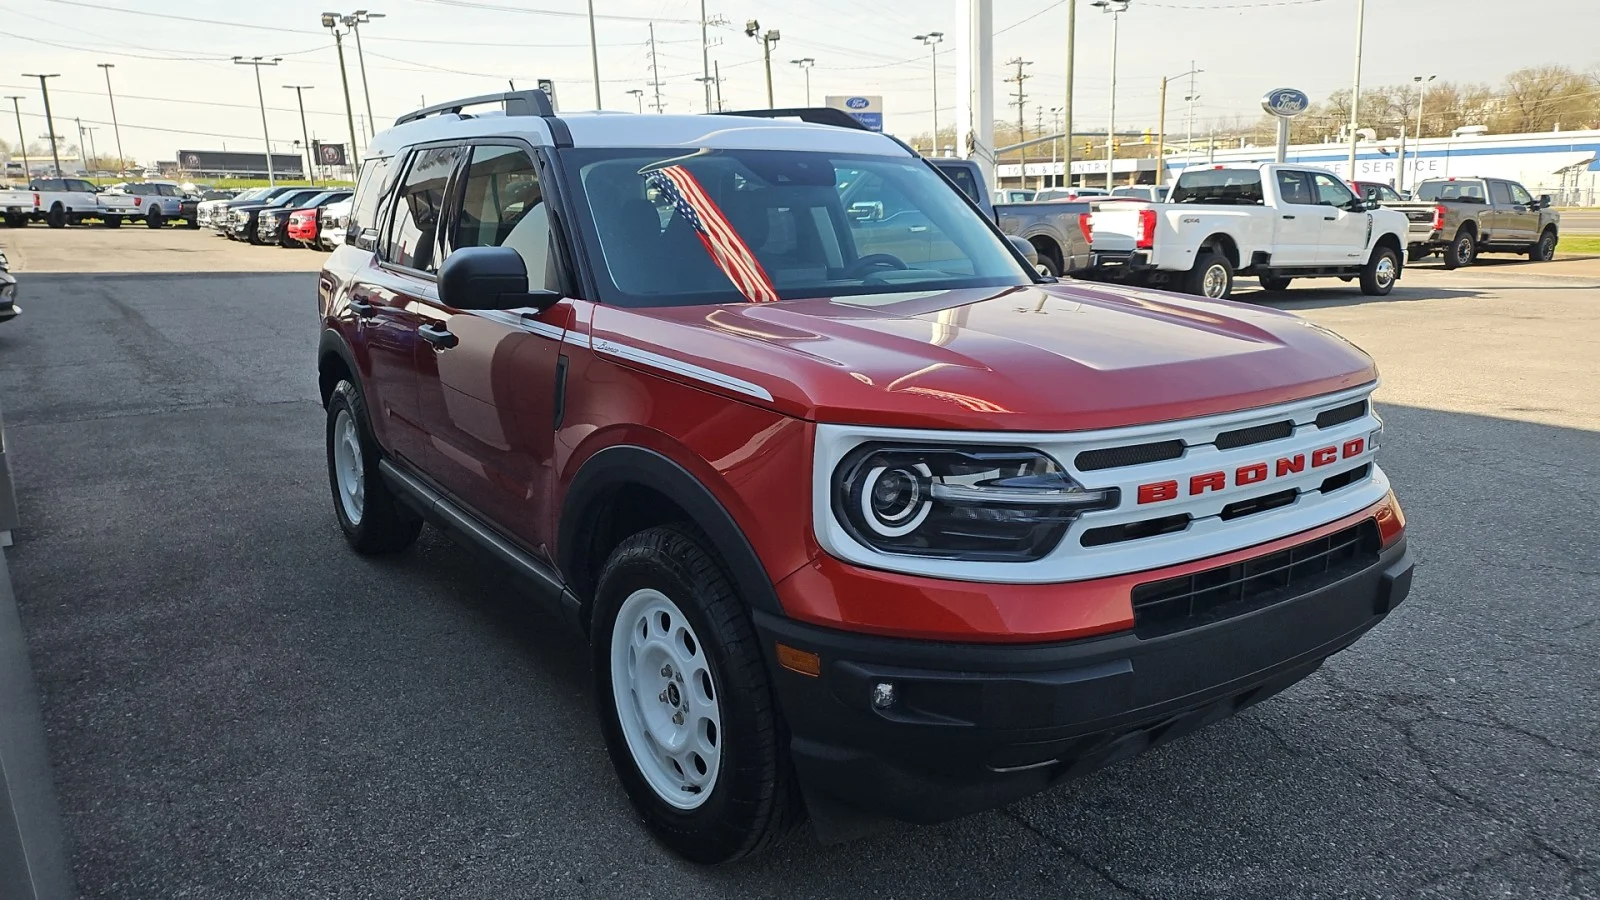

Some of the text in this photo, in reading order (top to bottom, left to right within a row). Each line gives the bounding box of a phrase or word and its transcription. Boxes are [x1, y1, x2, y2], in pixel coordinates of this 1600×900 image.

[851, 98, 866, 108] Ford
[1277, 93, 1302, 110] Ford
[1042, 165, 1047, 174] &
[1362, 160, 1438, 174] SERICE
[1137, 437, 1365, 505] BRONCO
